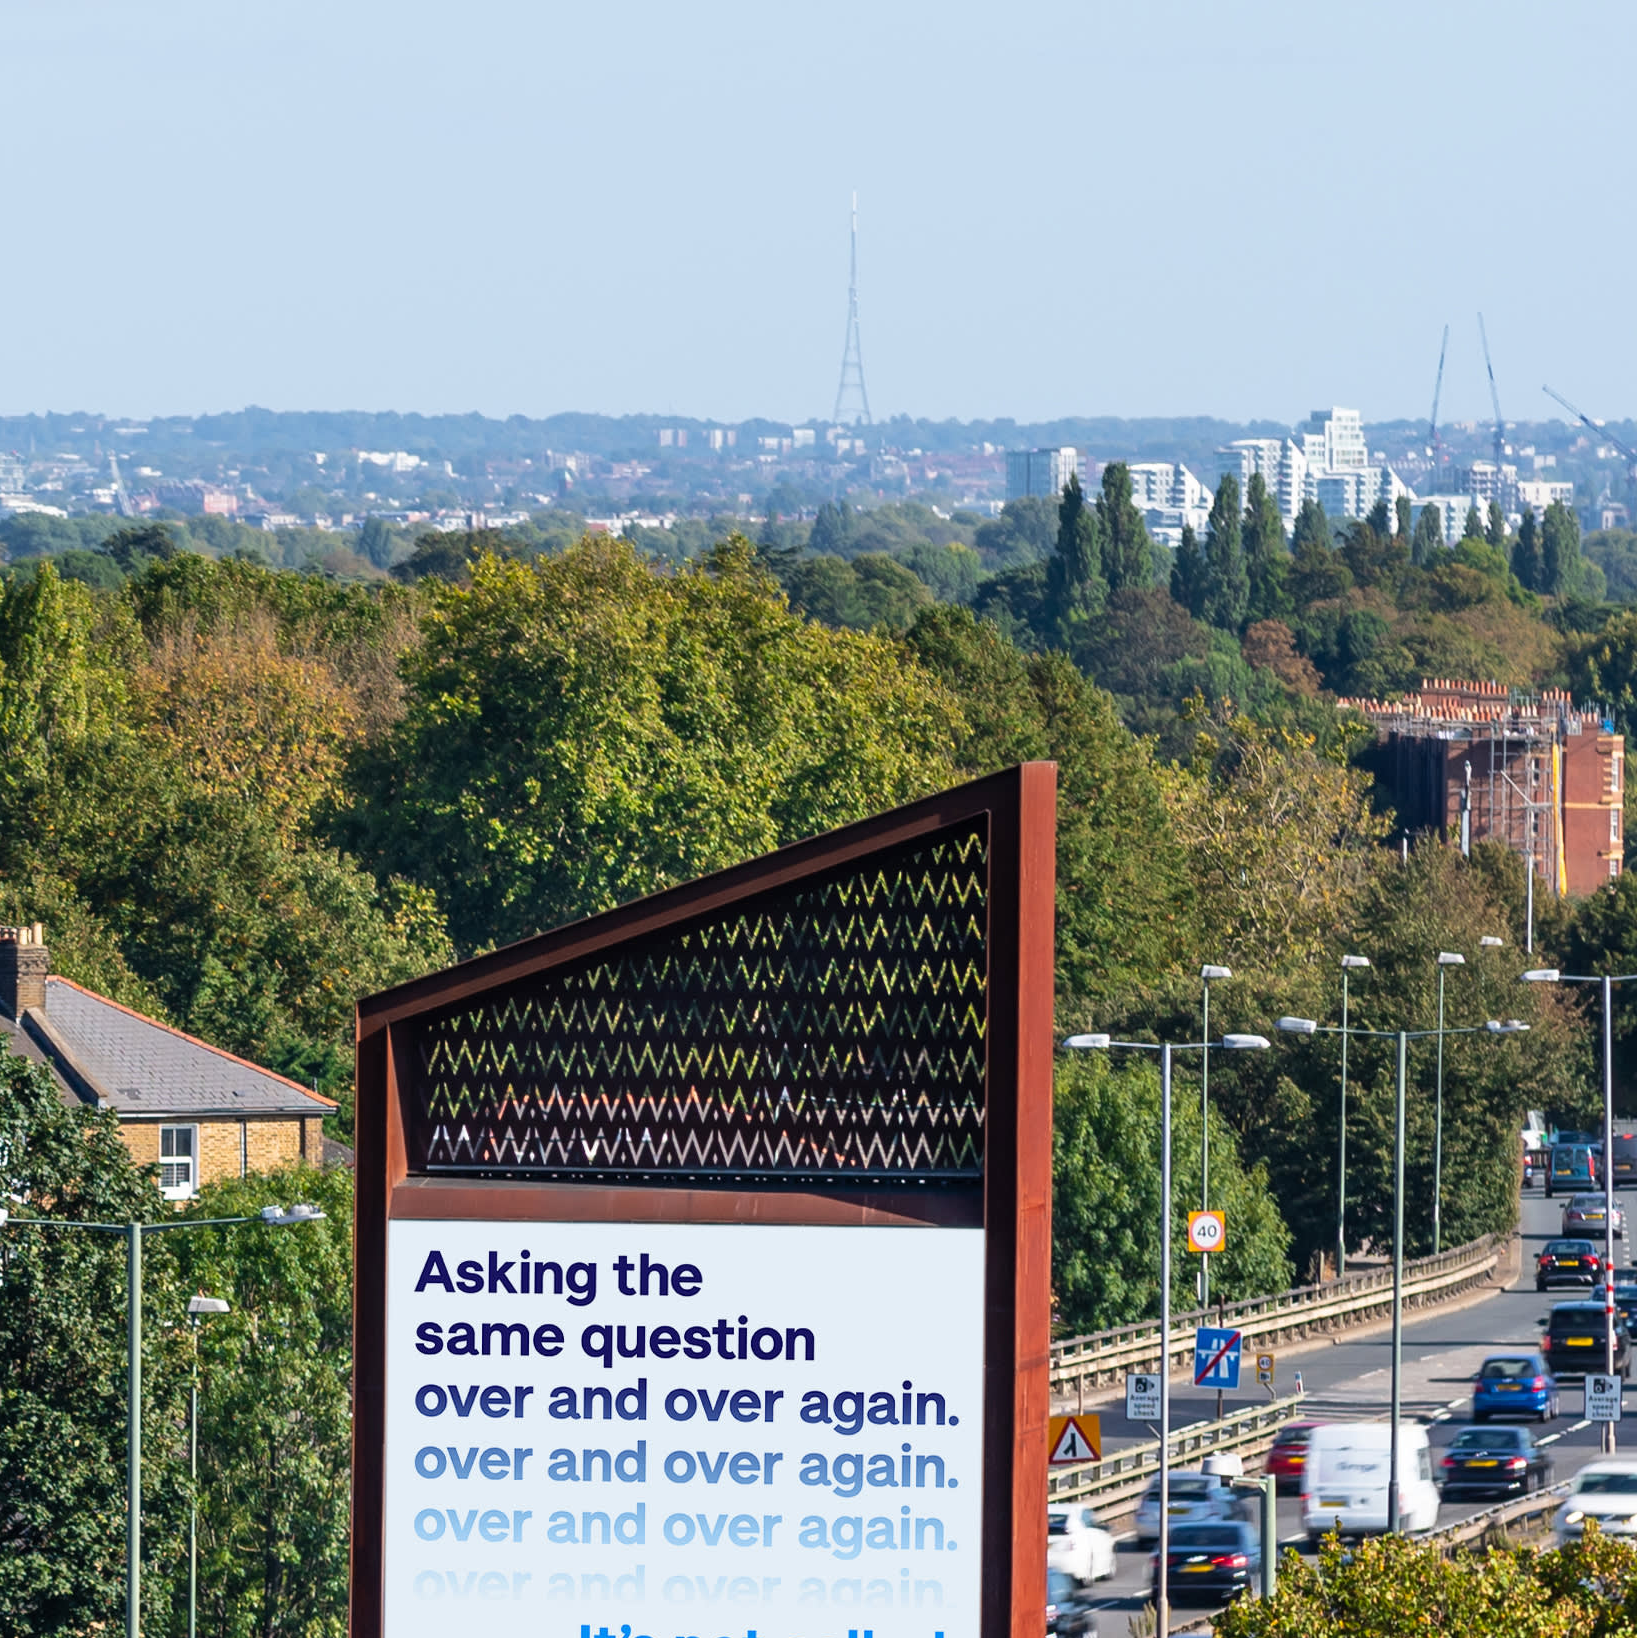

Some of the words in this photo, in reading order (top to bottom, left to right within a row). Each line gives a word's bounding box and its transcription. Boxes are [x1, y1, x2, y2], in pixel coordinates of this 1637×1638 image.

[1197, 1225, 1217, 1238] 40
[414, 1249, 597, 1307] Asking
[613, 1253, 703, 1297] the
[415, 1322, 564, 1357] same
[581, 1315, 814, 1368] question
[415, 1384, 534, 1418] over
[548, 1378, 647, 1421] and
[665, 1388, 784, 1423] over
[800, 1380, 959, 1436] again.
[415, 1446, 533, 1480] over
[548, 1440, 646, 1482] and
[664, 1450, 783, 1485] over
[799, 1443, 958, 1498] again.
[414, 1508, 533, 1542] over
[547, 1502, 645, 1545] and
[663, 1513, 782, 1547] over
[799, 1505, 957, 1560] again.
